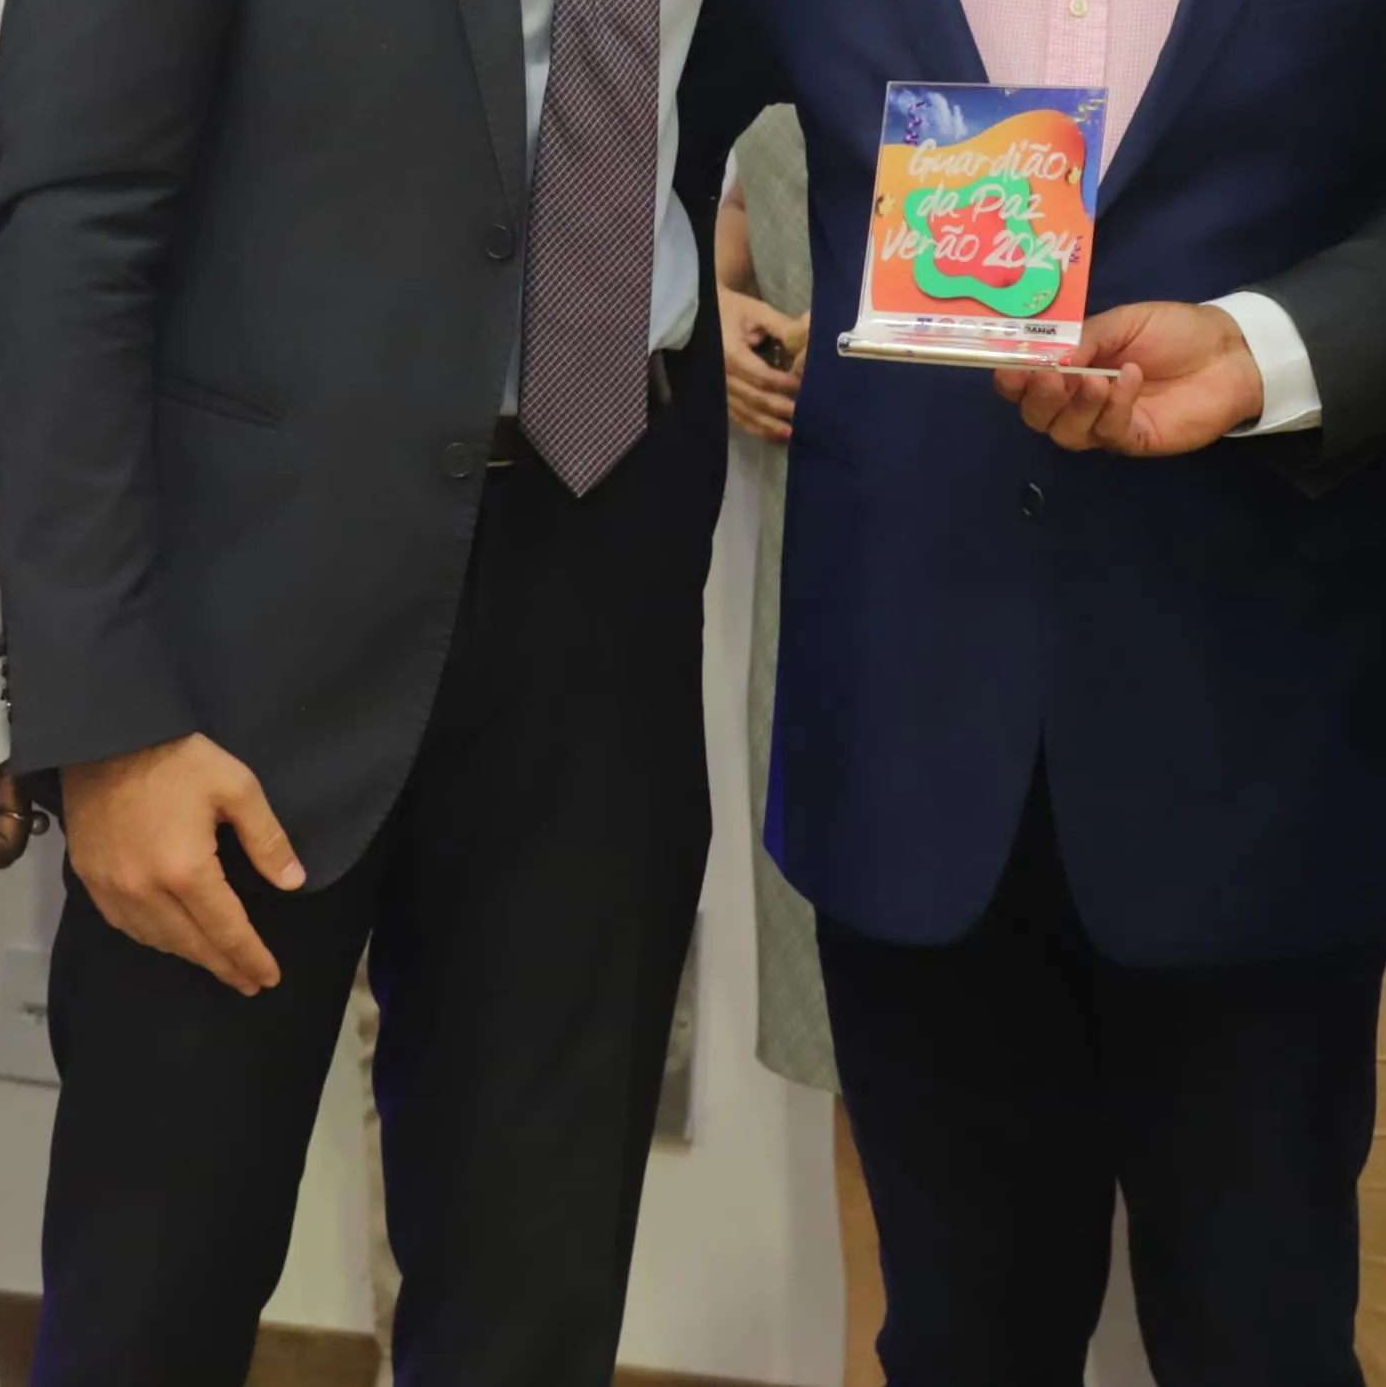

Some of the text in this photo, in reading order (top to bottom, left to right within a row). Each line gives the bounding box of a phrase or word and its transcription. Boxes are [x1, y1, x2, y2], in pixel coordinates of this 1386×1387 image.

[907, 138, 1067, 183] Guardião
[917, 181, 1047, 223] da Paz
[881, 221, 1076, 272] Verão 2024
